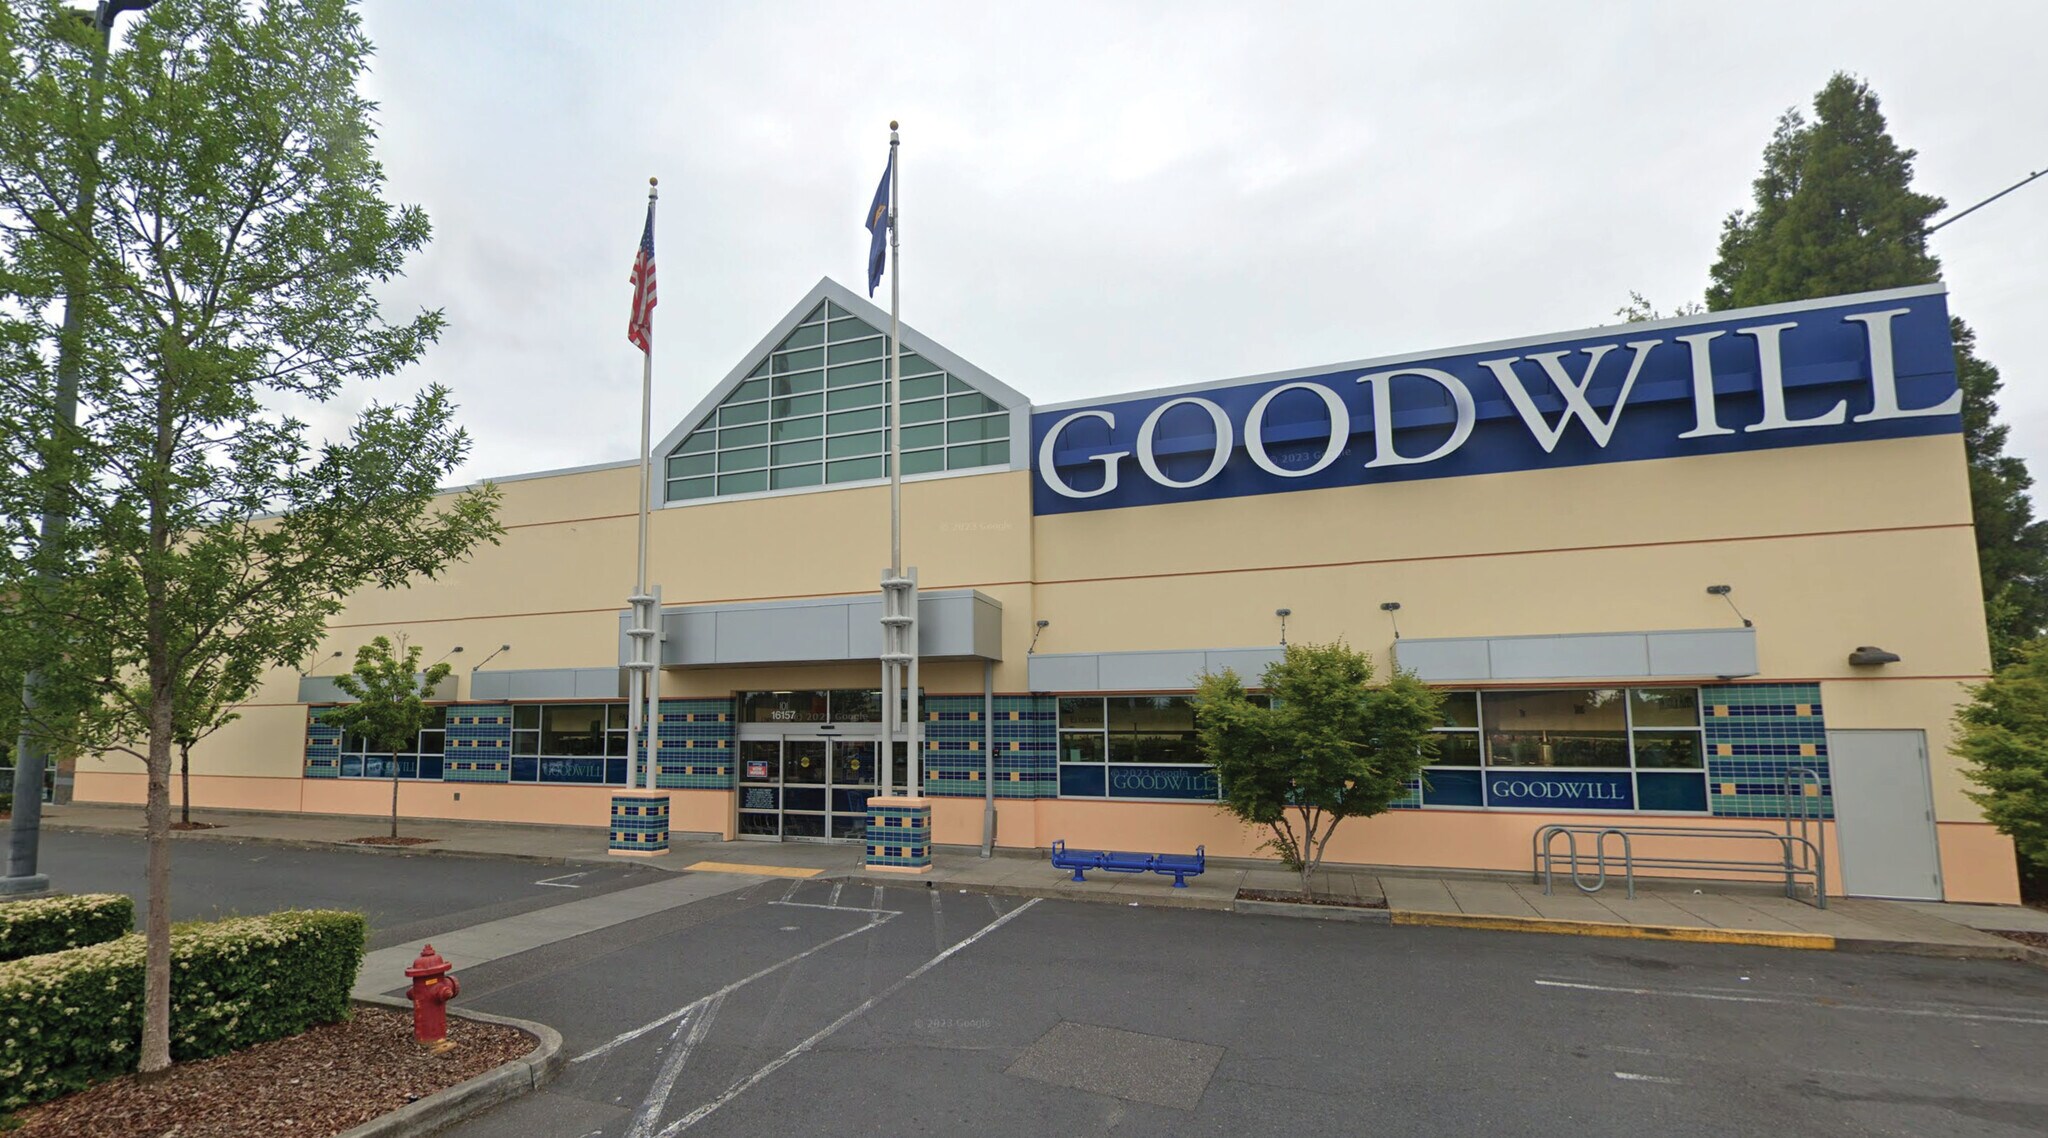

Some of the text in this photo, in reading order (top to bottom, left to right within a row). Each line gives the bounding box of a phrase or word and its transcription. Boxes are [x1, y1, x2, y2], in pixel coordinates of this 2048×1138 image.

[1038, 307, 1964, 499] GOODWILL
[771, 710, 796, 720] 16157
[1113, 775, 1214, 790] GOODWILL
[1492, 780, 1625, 800] GOODWILL
